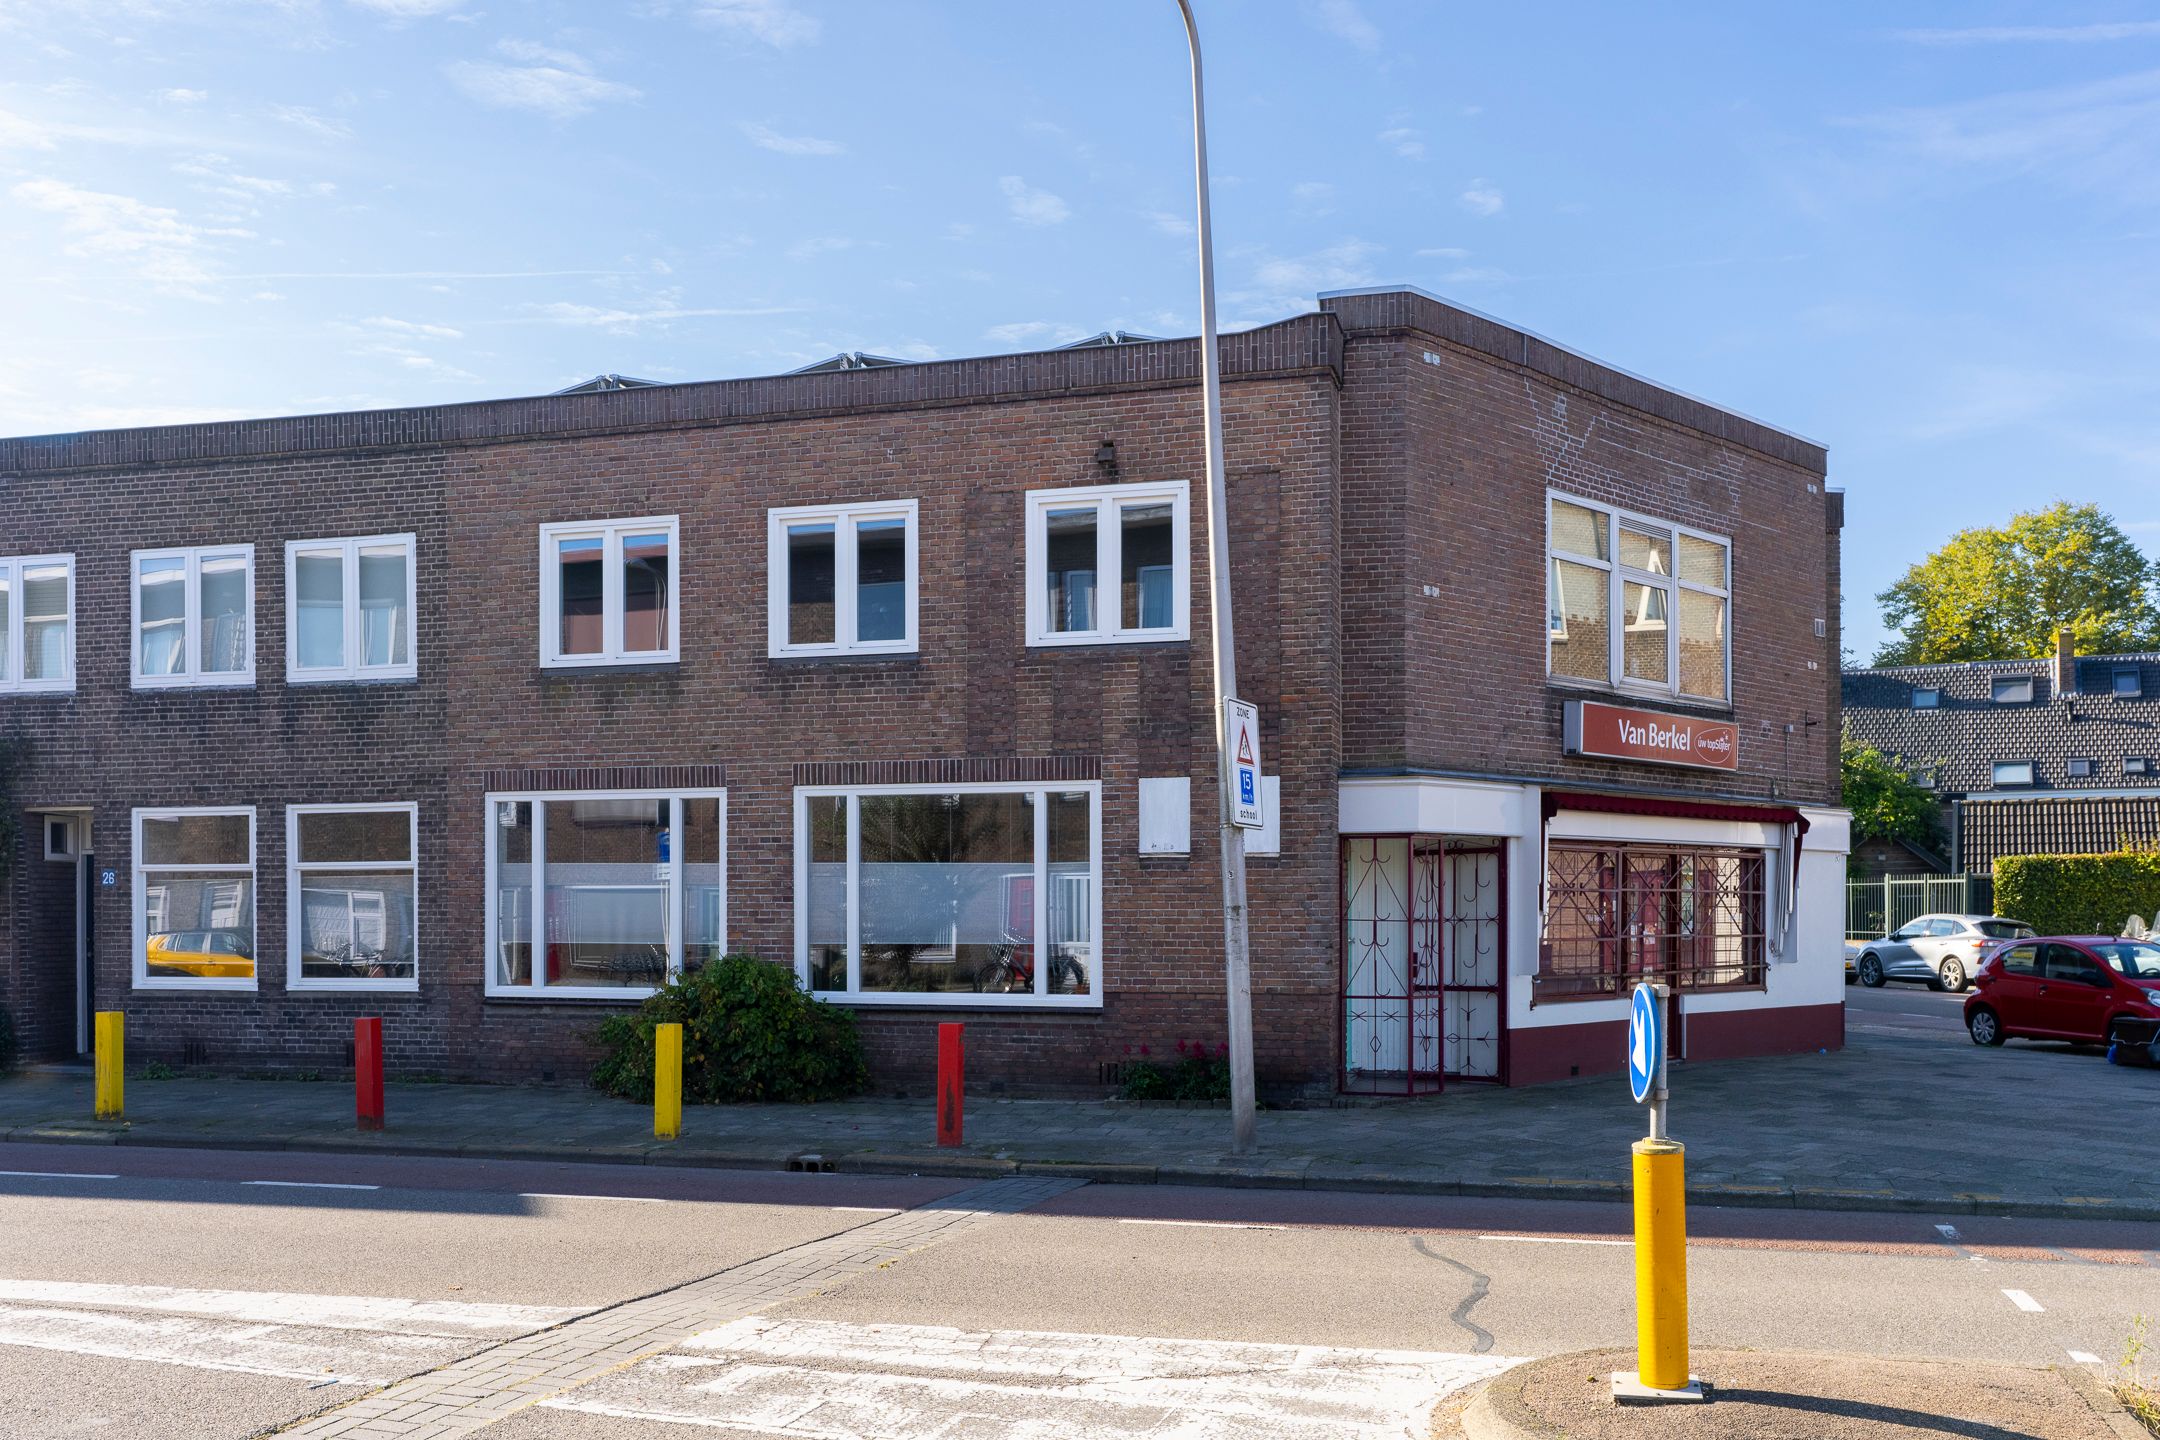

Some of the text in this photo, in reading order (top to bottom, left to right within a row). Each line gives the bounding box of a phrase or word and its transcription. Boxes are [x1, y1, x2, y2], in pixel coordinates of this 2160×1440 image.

[1236, 706, 1250, 719] ZONE
[1618, 718, 1691, 752] Van Berkel
[1242, 773, 1252, 790] 15
[1240, 809, 1258, 820] school
[102, 871, 115, 884] 26
